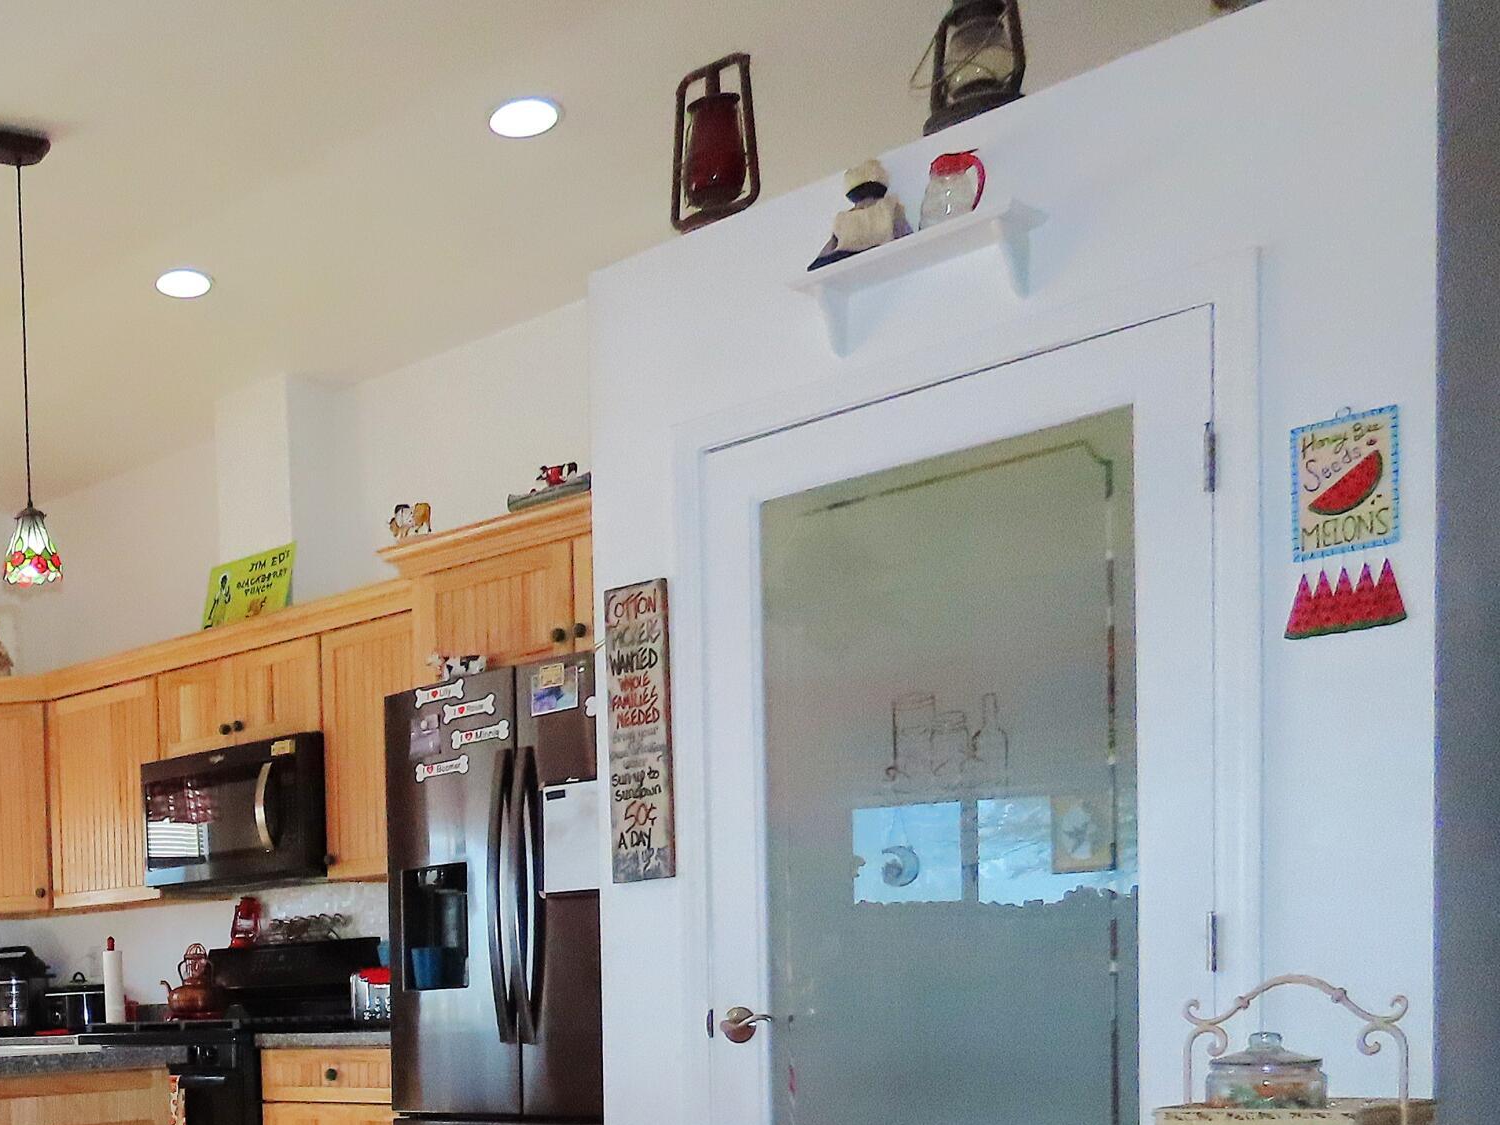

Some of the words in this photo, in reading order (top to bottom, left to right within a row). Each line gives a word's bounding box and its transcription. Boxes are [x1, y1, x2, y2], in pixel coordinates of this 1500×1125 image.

[1303, 446, 1362, 492] Seeds
[1301, 507, 1390, 551] MELONS
[605, 588, 657, 629] COTTON
[609, 647, 659, 677] WANTED
[612, 685, 659, 712] FAMILIES
[616, 706, 661, 730] NEEDED
[618, 832, 628, 850] A
[630, 828, 652, 850] DAY
